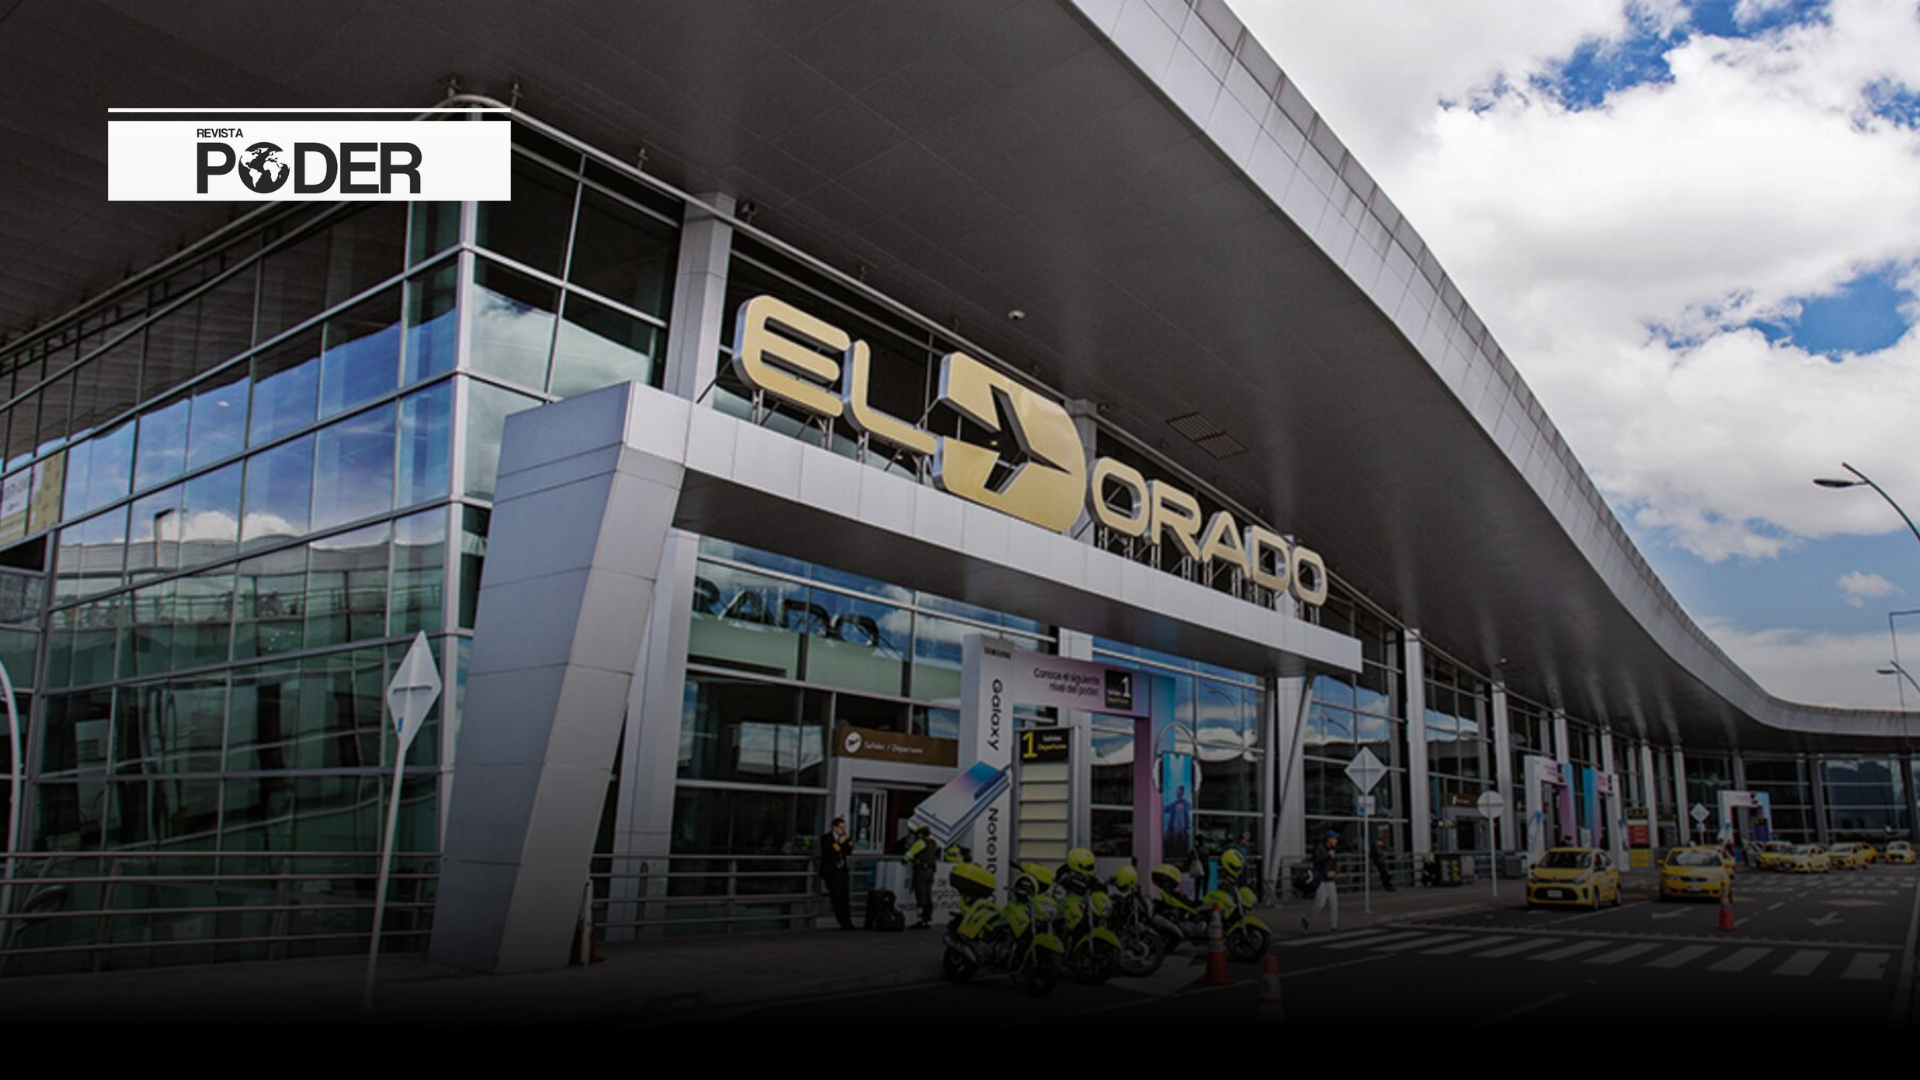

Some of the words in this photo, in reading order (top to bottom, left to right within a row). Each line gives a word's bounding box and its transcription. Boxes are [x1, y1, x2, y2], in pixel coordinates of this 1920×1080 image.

[733, 295, 937, 455] EL
[1121, 675, 1131, 698] 1
[987, 679, 1003, 750] Galaxy
[1022, 730, 1038, 759] 1
